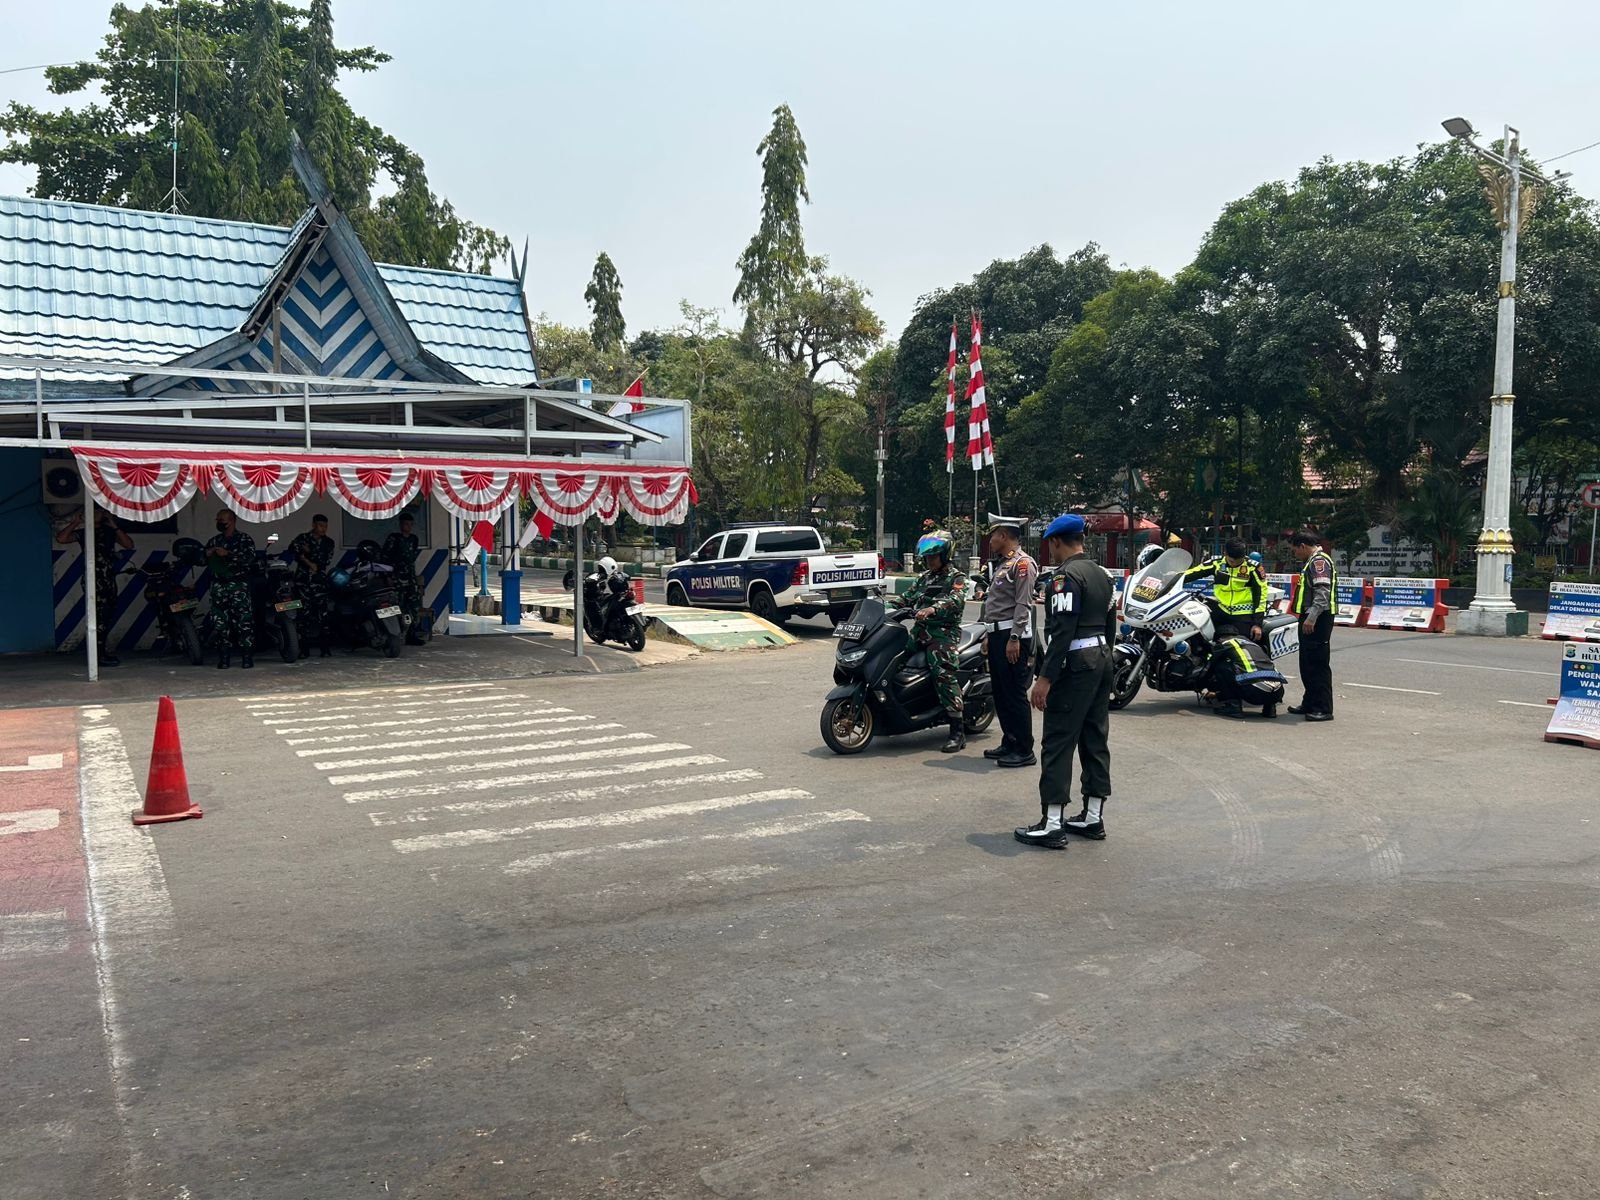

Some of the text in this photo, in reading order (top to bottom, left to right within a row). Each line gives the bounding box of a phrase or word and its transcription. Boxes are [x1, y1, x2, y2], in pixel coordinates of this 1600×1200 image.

[691, 575, 740, 590] POLISI MILITER
[816, 569, 873, 582] POLISI MILITER
[1051, 592, 1073, 615] PM
[1588, 646, 1600, 654] SA
